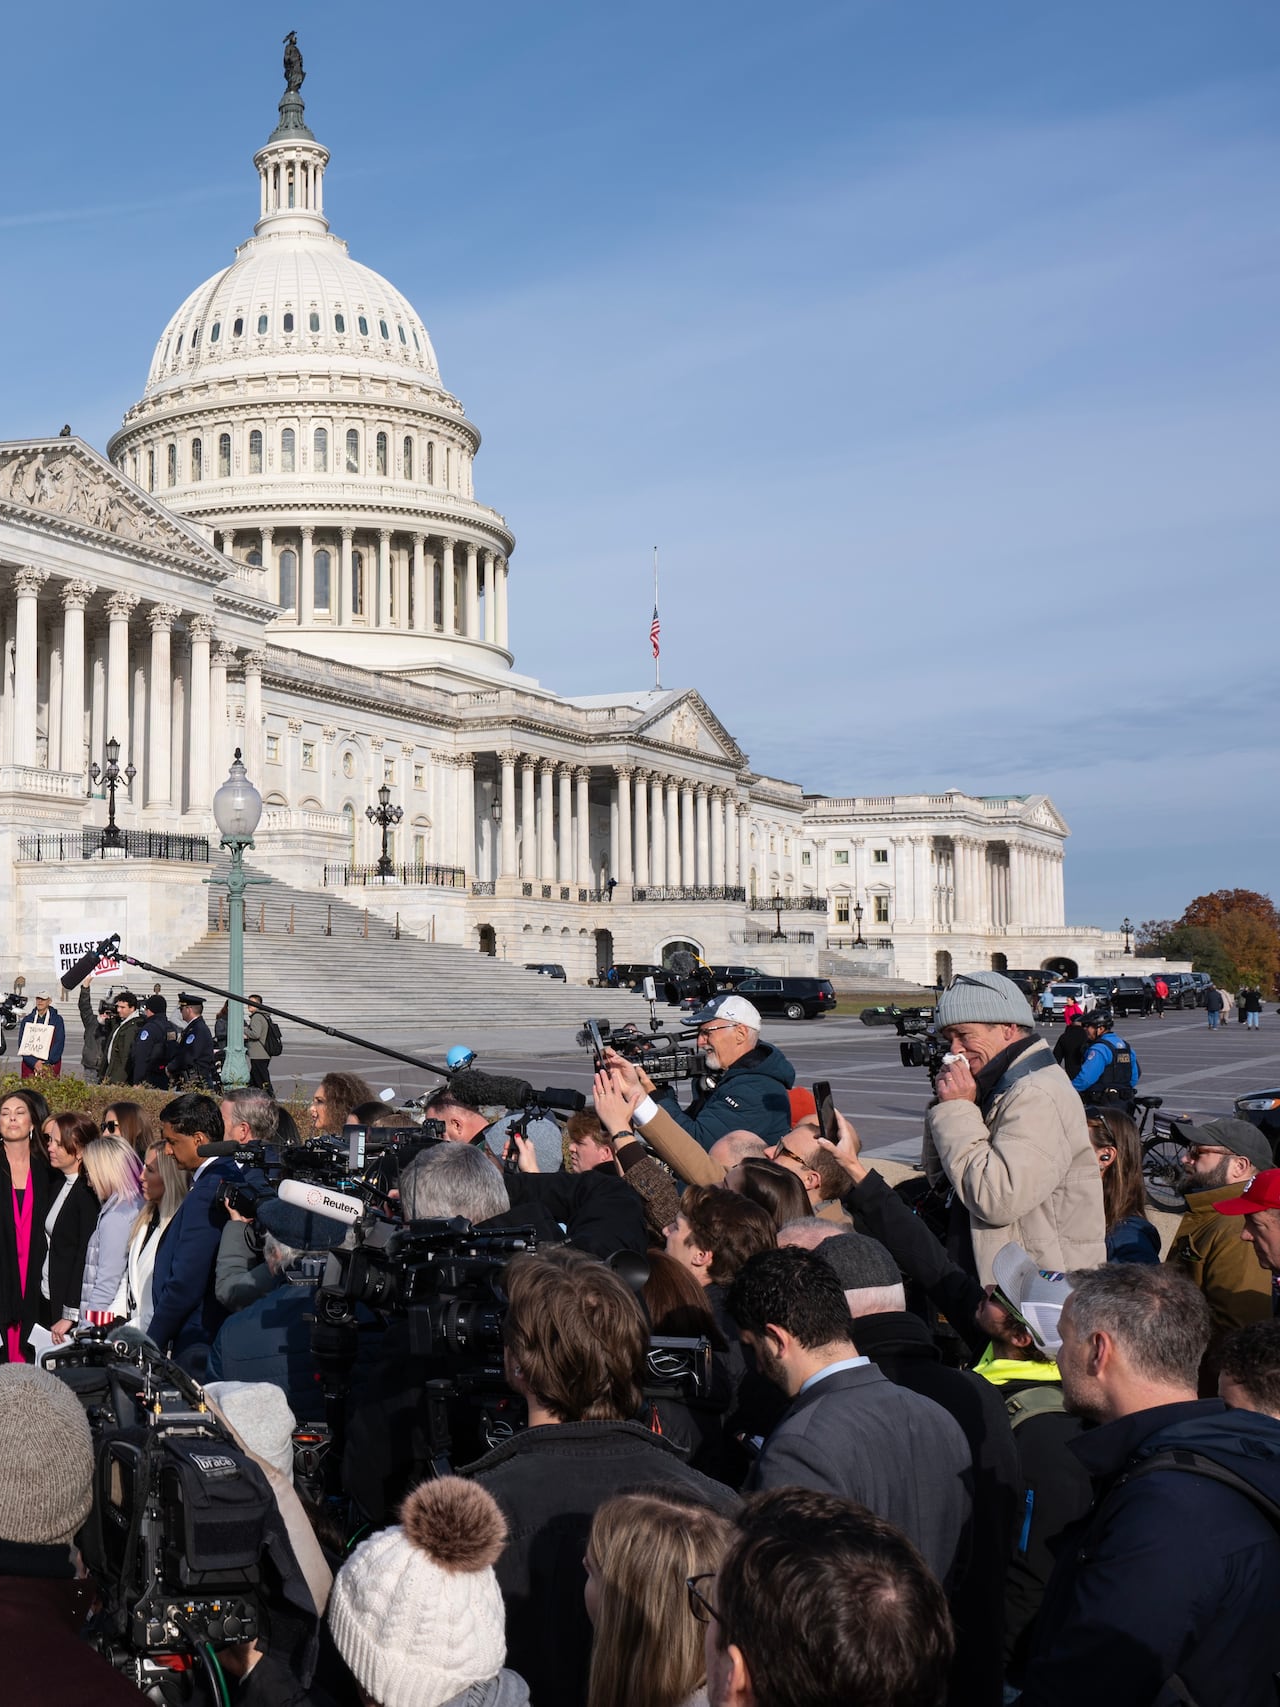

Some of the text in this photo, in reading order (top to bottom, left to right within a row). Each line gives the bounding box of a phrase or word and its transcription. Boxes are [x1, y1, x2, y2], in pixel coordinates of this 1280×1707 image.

[60, 941, 95, 955] RELEASE
[322, 1196, 359, 1215] Reuters
[200, 1457, 232, 1469] brace
